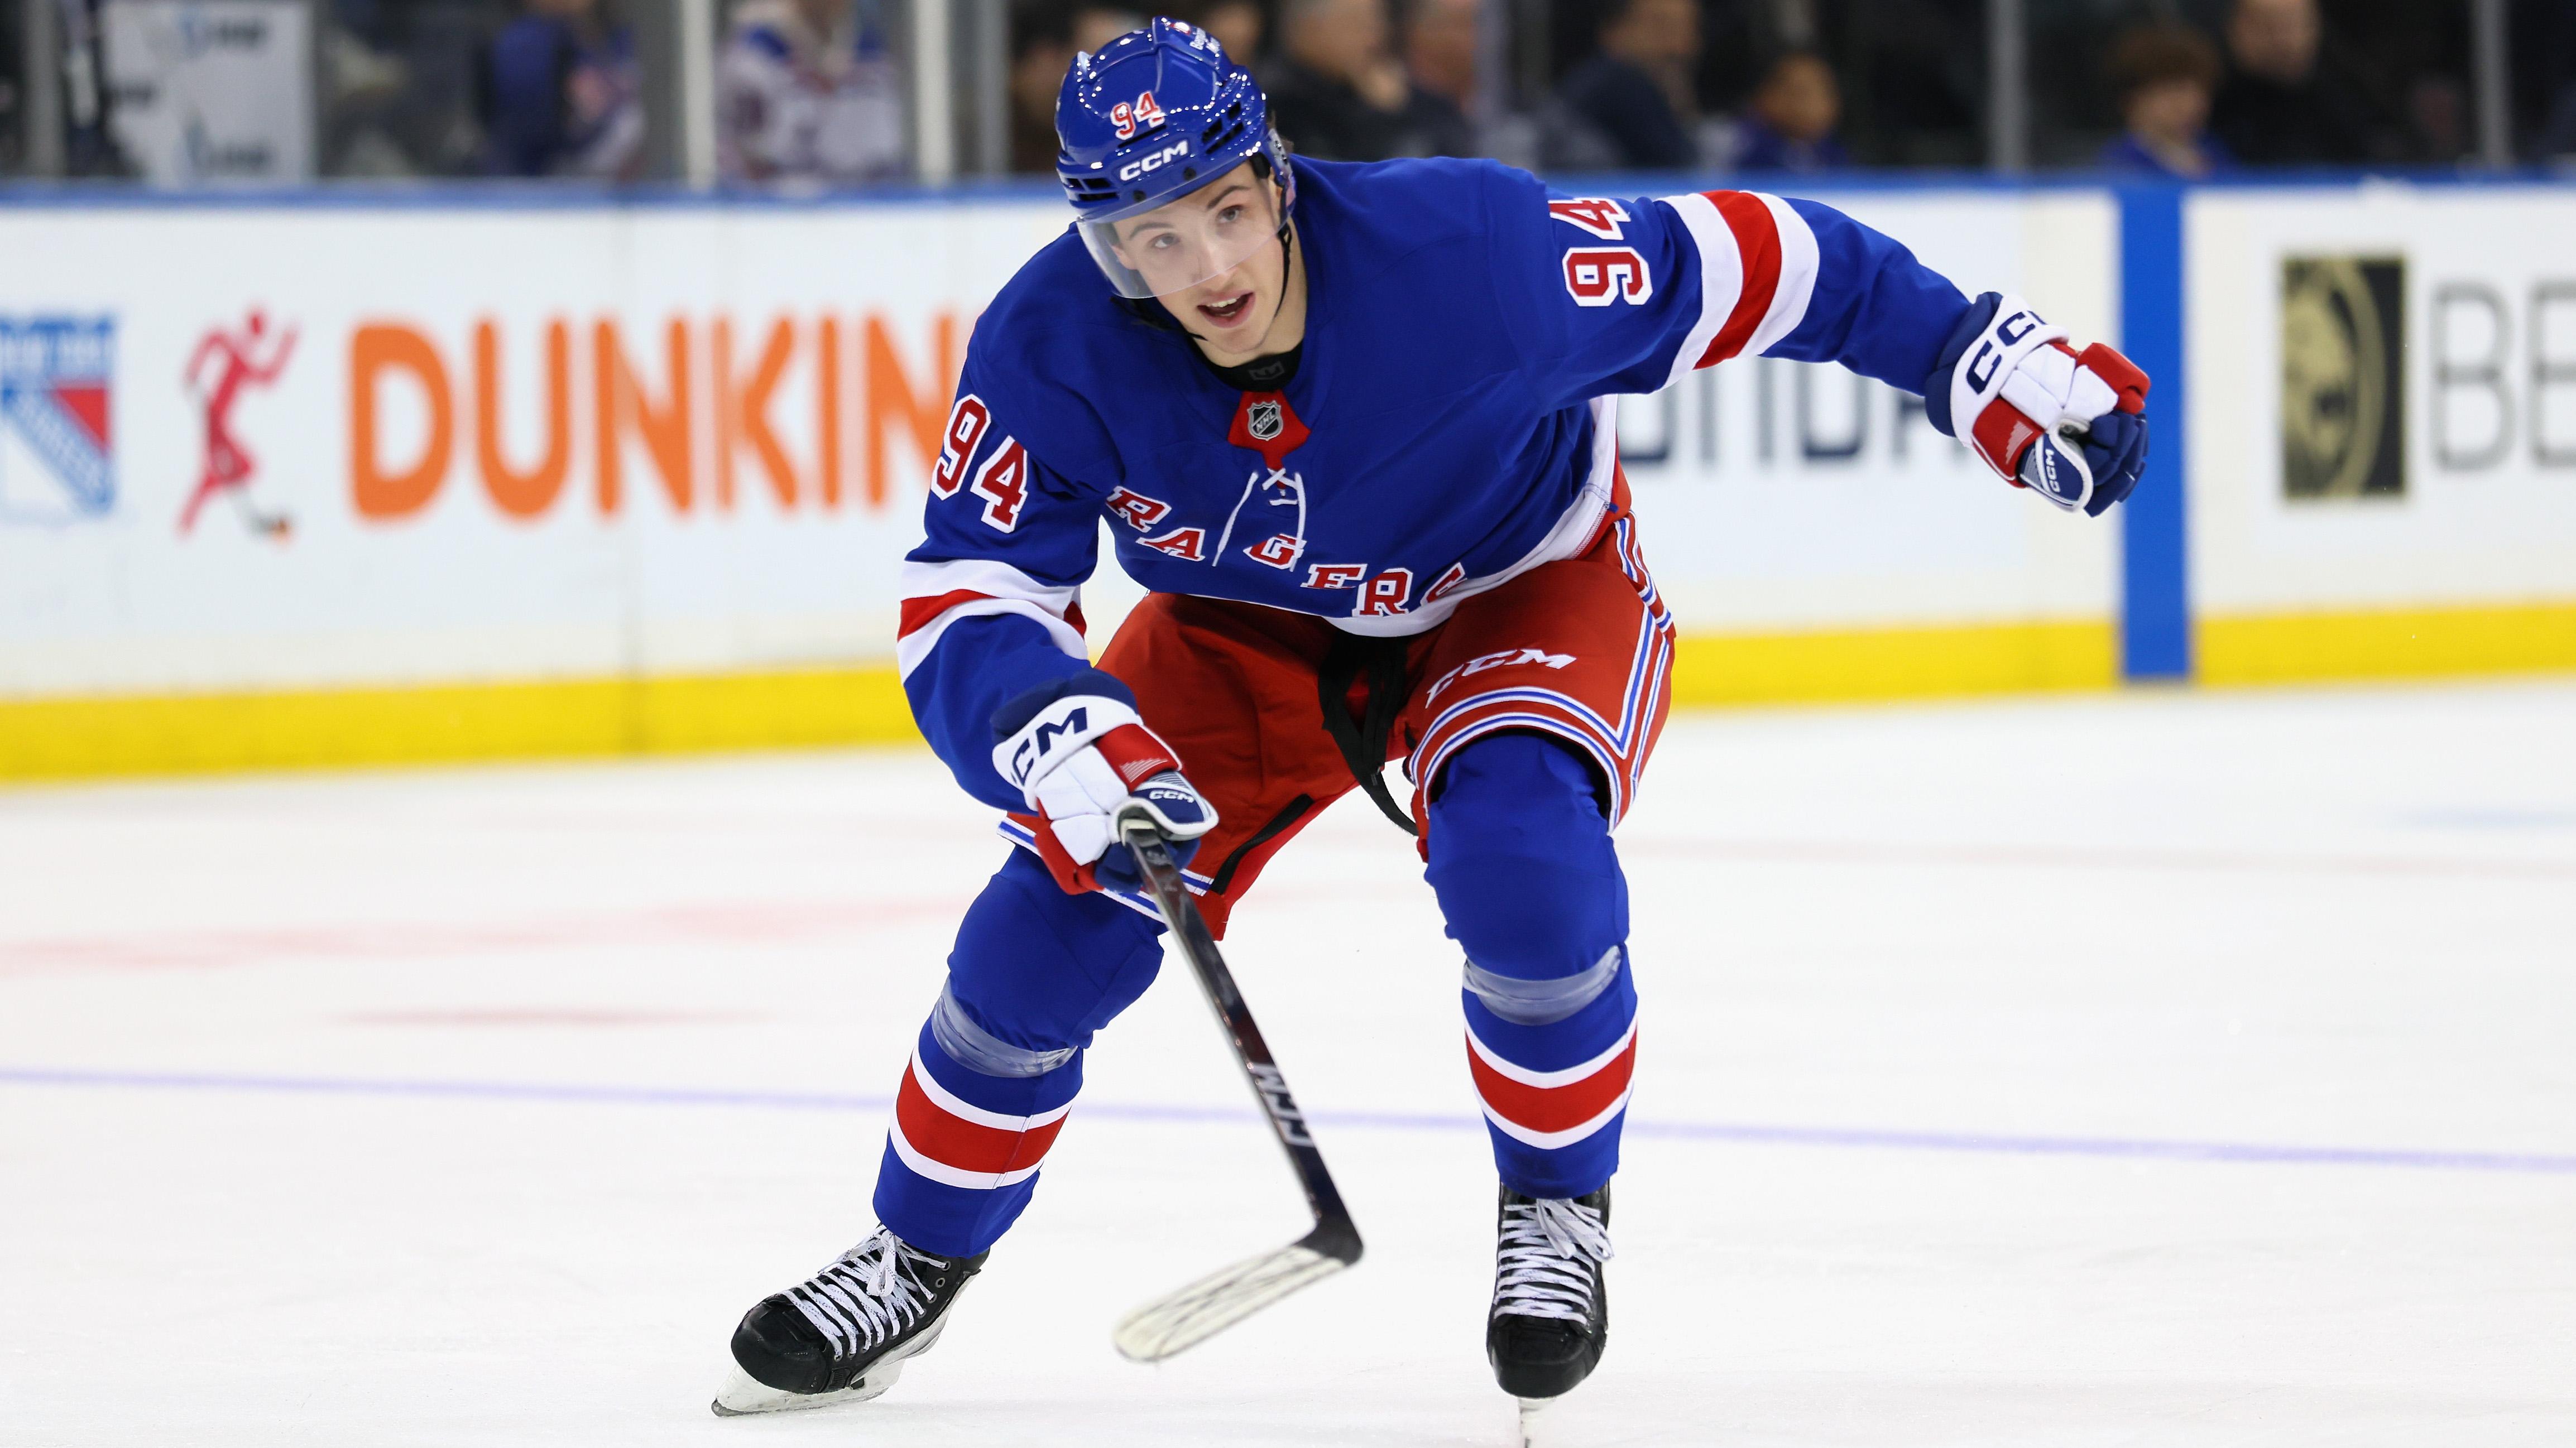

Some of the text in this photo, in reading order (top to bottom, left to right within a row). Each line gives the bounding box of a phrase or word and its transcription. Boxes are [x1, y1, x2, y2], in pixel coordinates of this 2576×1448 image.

[1110, 90, 1165, 140] 94
[1119, 140, 1188, 181] CCM
[1547, 198, 1653, 307] 94
[1966, 310, 2048, 395] CC
[352, 318, 957, 516] DUNKIN
[1255, 411, 1276, 434] NHL
[930, 393, 1028, 534] 94
[2045, 449, 2061, 493] CCM
[1425, 648, 1577, 709] CCM
[1010, 706, 1088, 786] CM
[1149, 790, 1196, 804] CCM
